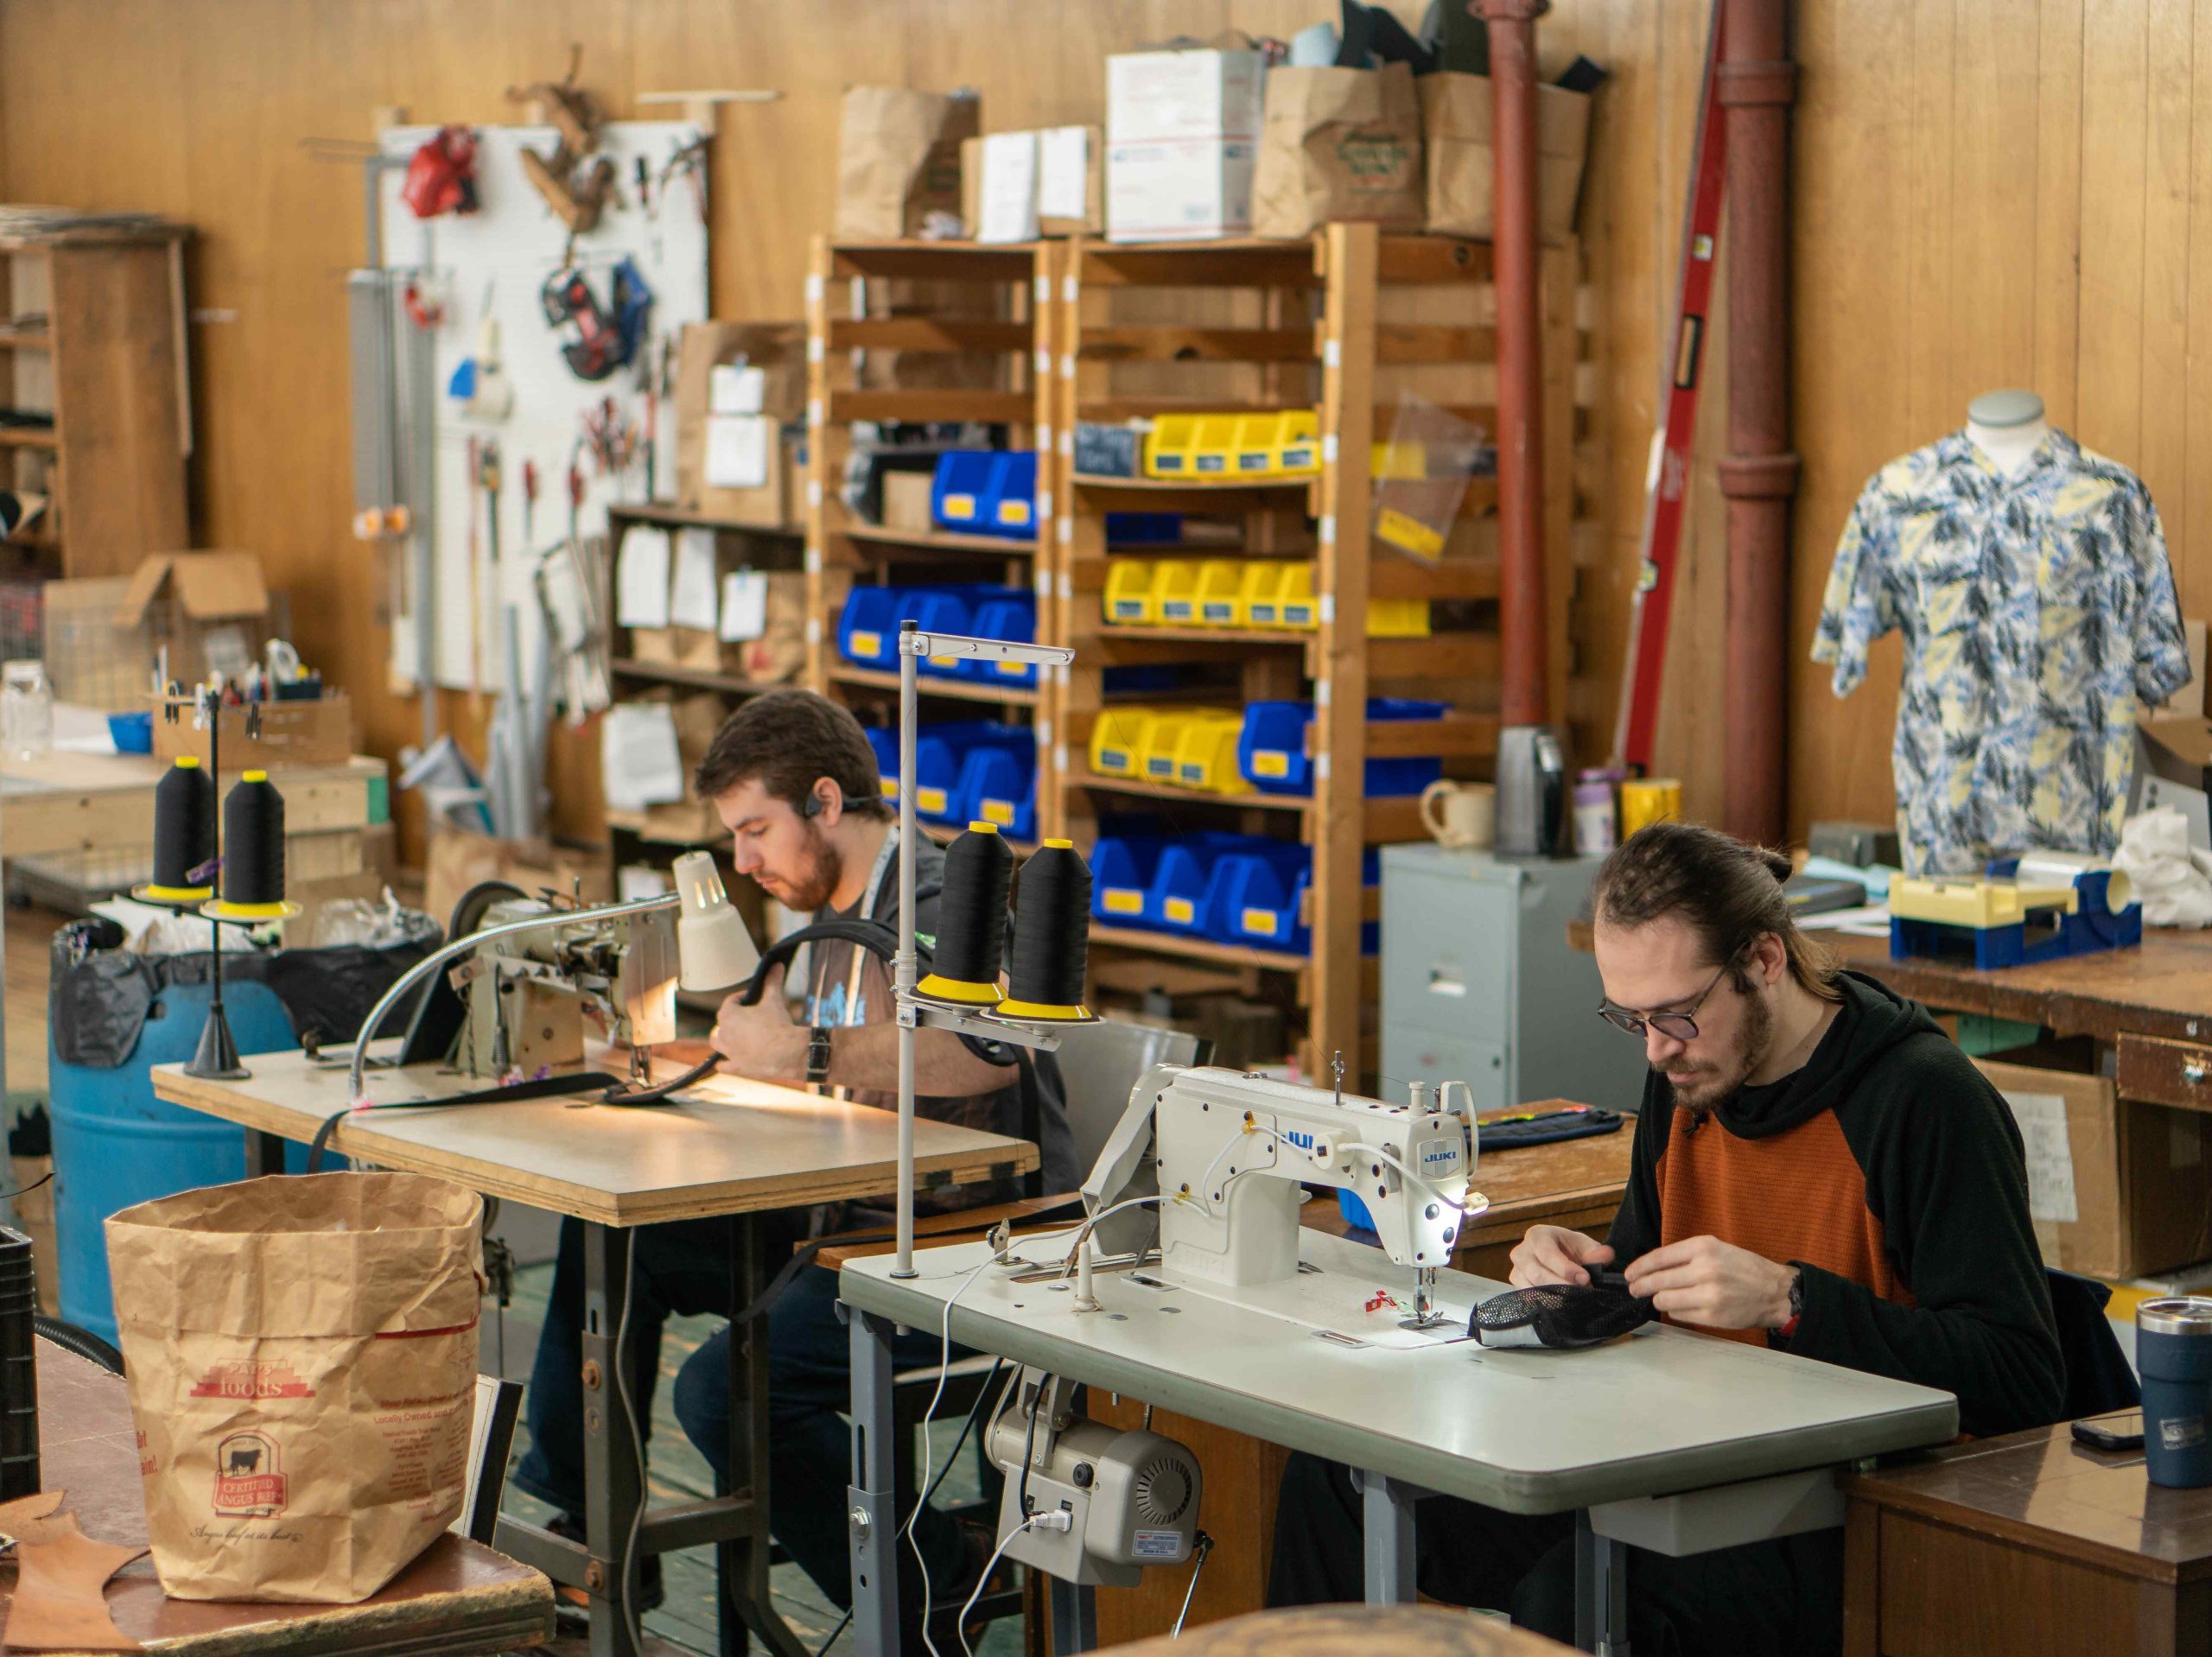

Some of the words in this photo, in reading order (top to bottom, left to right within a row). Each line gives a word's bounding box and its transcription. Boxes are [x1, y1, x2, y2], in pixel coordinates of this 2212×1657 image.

[1425, 1151, 1456, 1163] JUKI
[220, 1376, 283, 1397] foods
[374, 1414, 402, 1424] Locally
[404, 1411, 432, 1421] Owned
[224, 1478, 274, 1493] CERTIFIED
[218, 1493, 254, 1505] ANGUS
